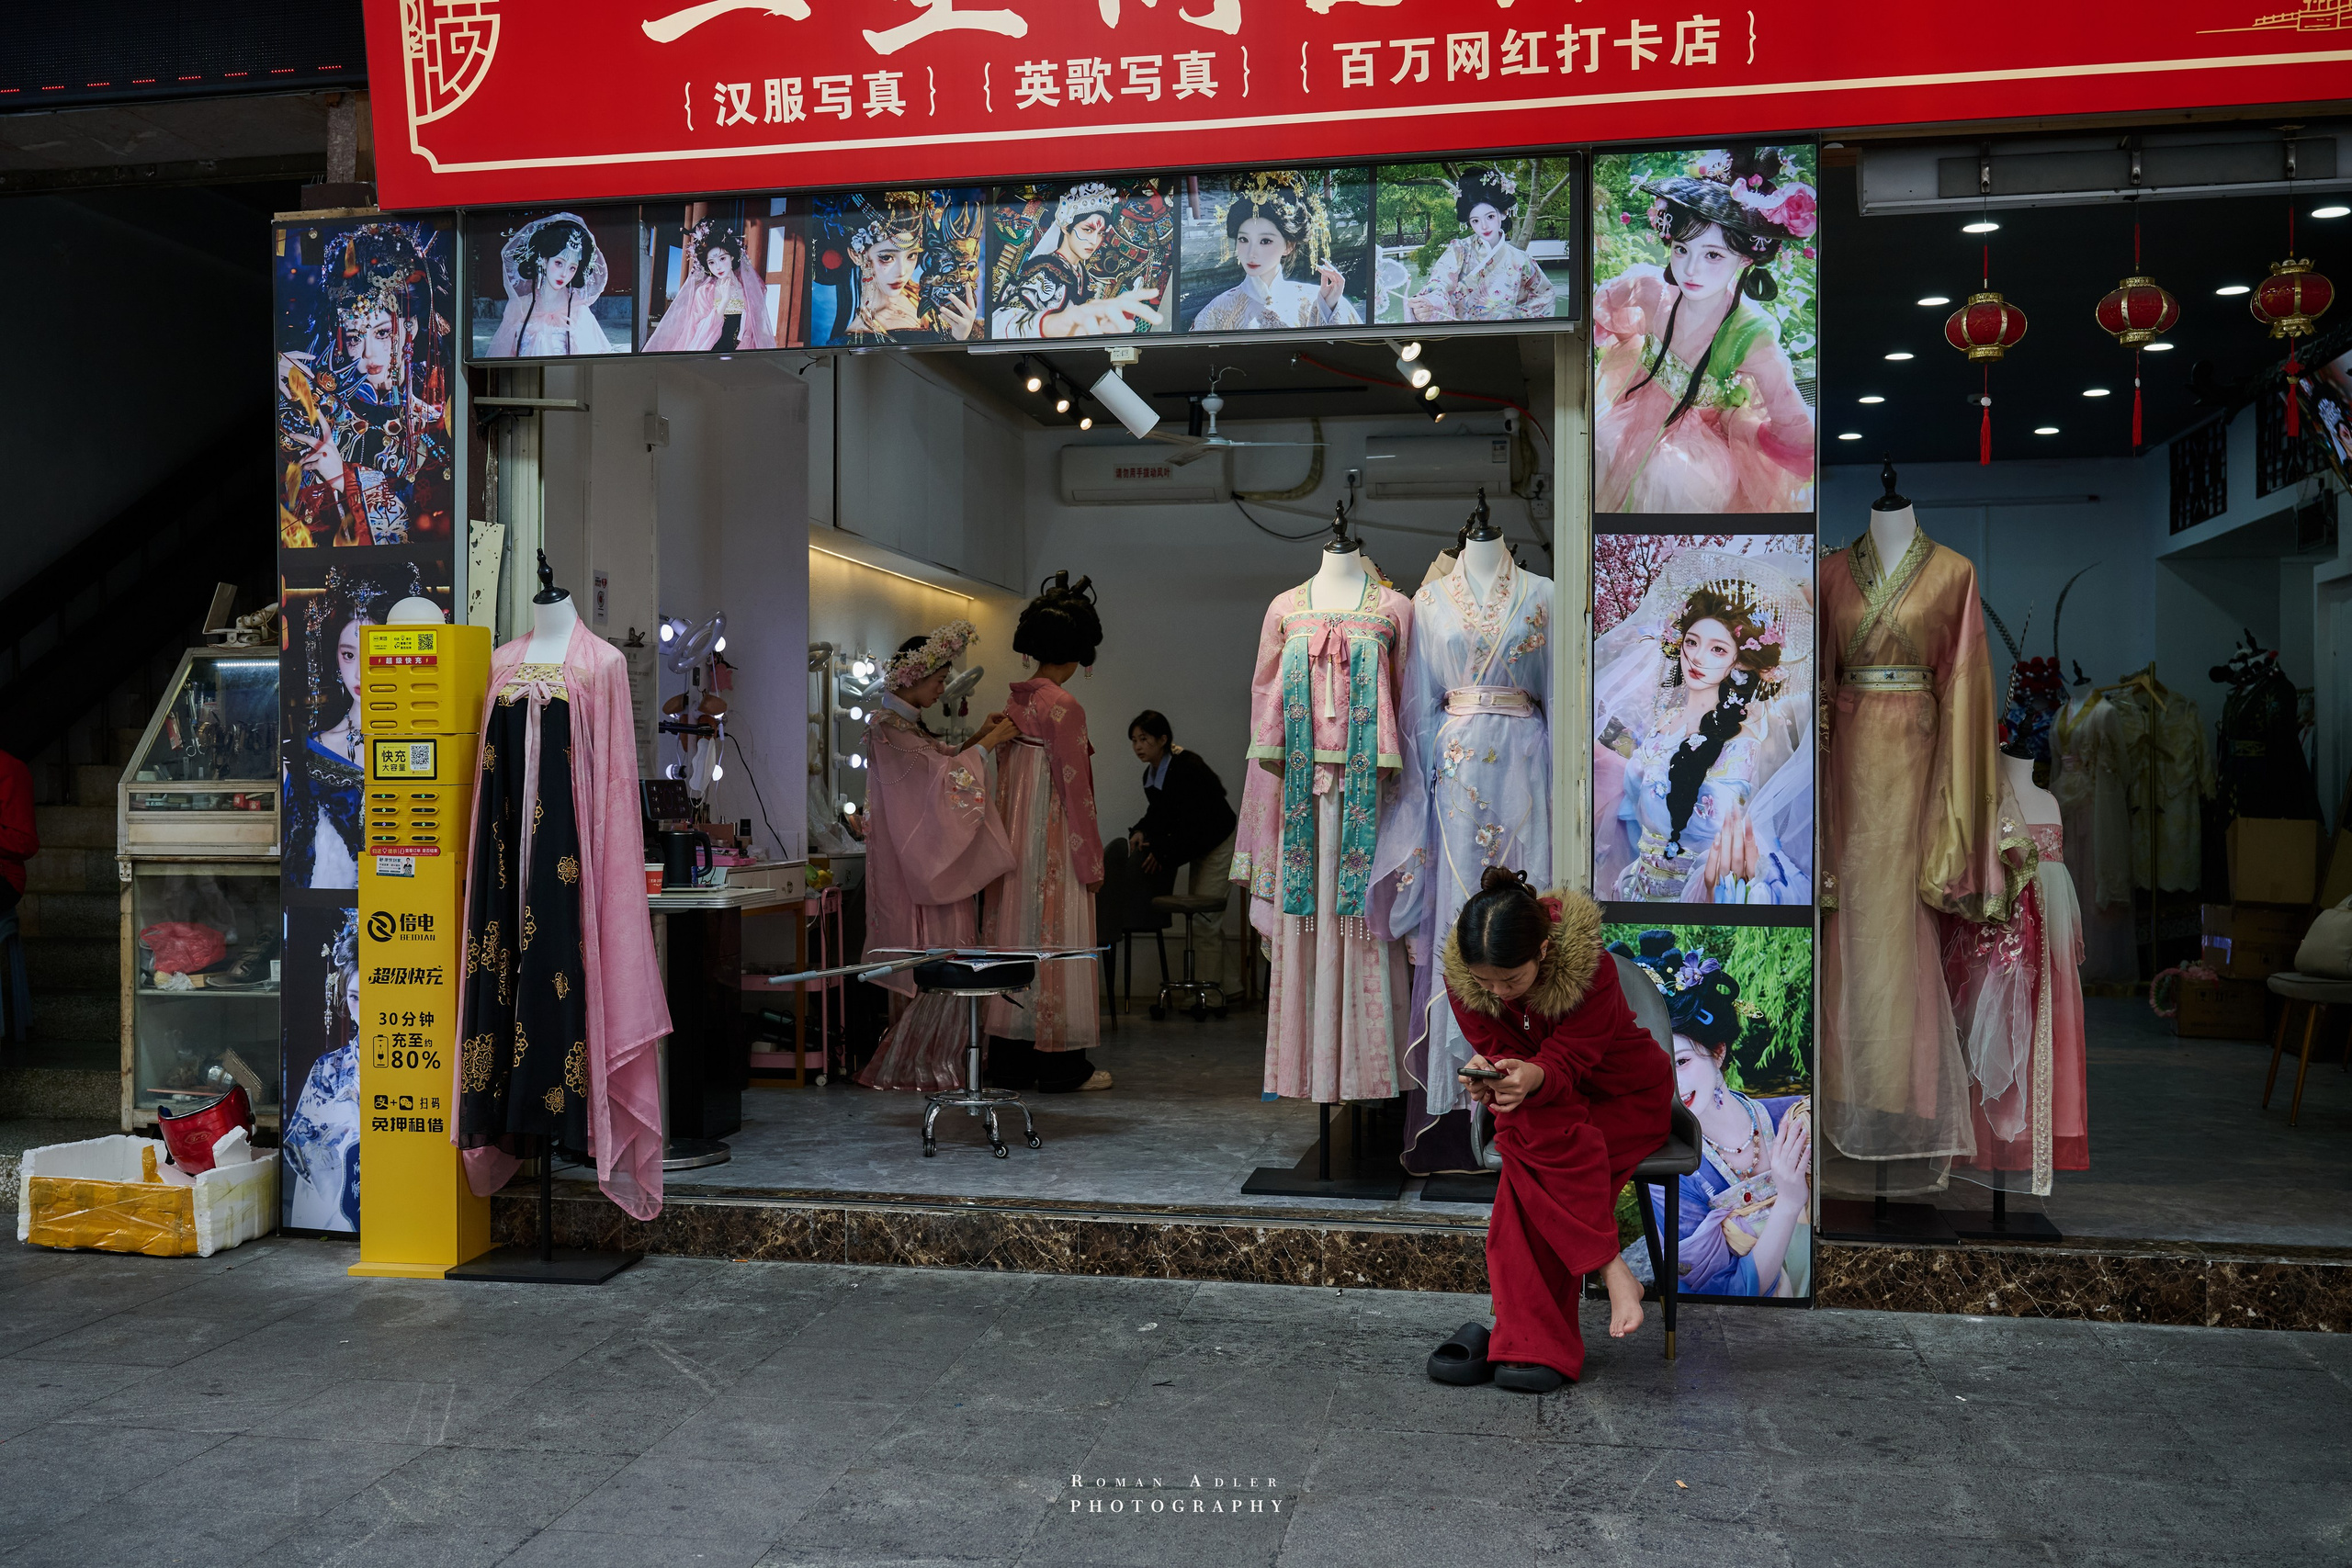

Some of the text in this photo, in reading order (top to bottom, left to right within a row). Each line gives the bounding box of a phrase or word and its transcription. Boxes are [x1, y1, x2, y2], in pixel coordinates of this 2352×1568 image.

[714, 14, 1722, 128] 汉服写真 英歌写真 百万网红打卡店
[385, 657, 423, 665] 超级快充
[381, 750, 406, 763] 快充
[382, 763, 406, 772] 大容量
[400, 913, 435, 932] 倍电
[369, 965, 444, 986] 超级快充
[379, 1011, 435, 1028] 30分钟
[391, 1032, 433, 1048] 充至约
[391, 1050, 441, 1069] 80%
[419, 1097, 440, 1110] 扫码
[371, 1117, 444, 1133] 免押租借
